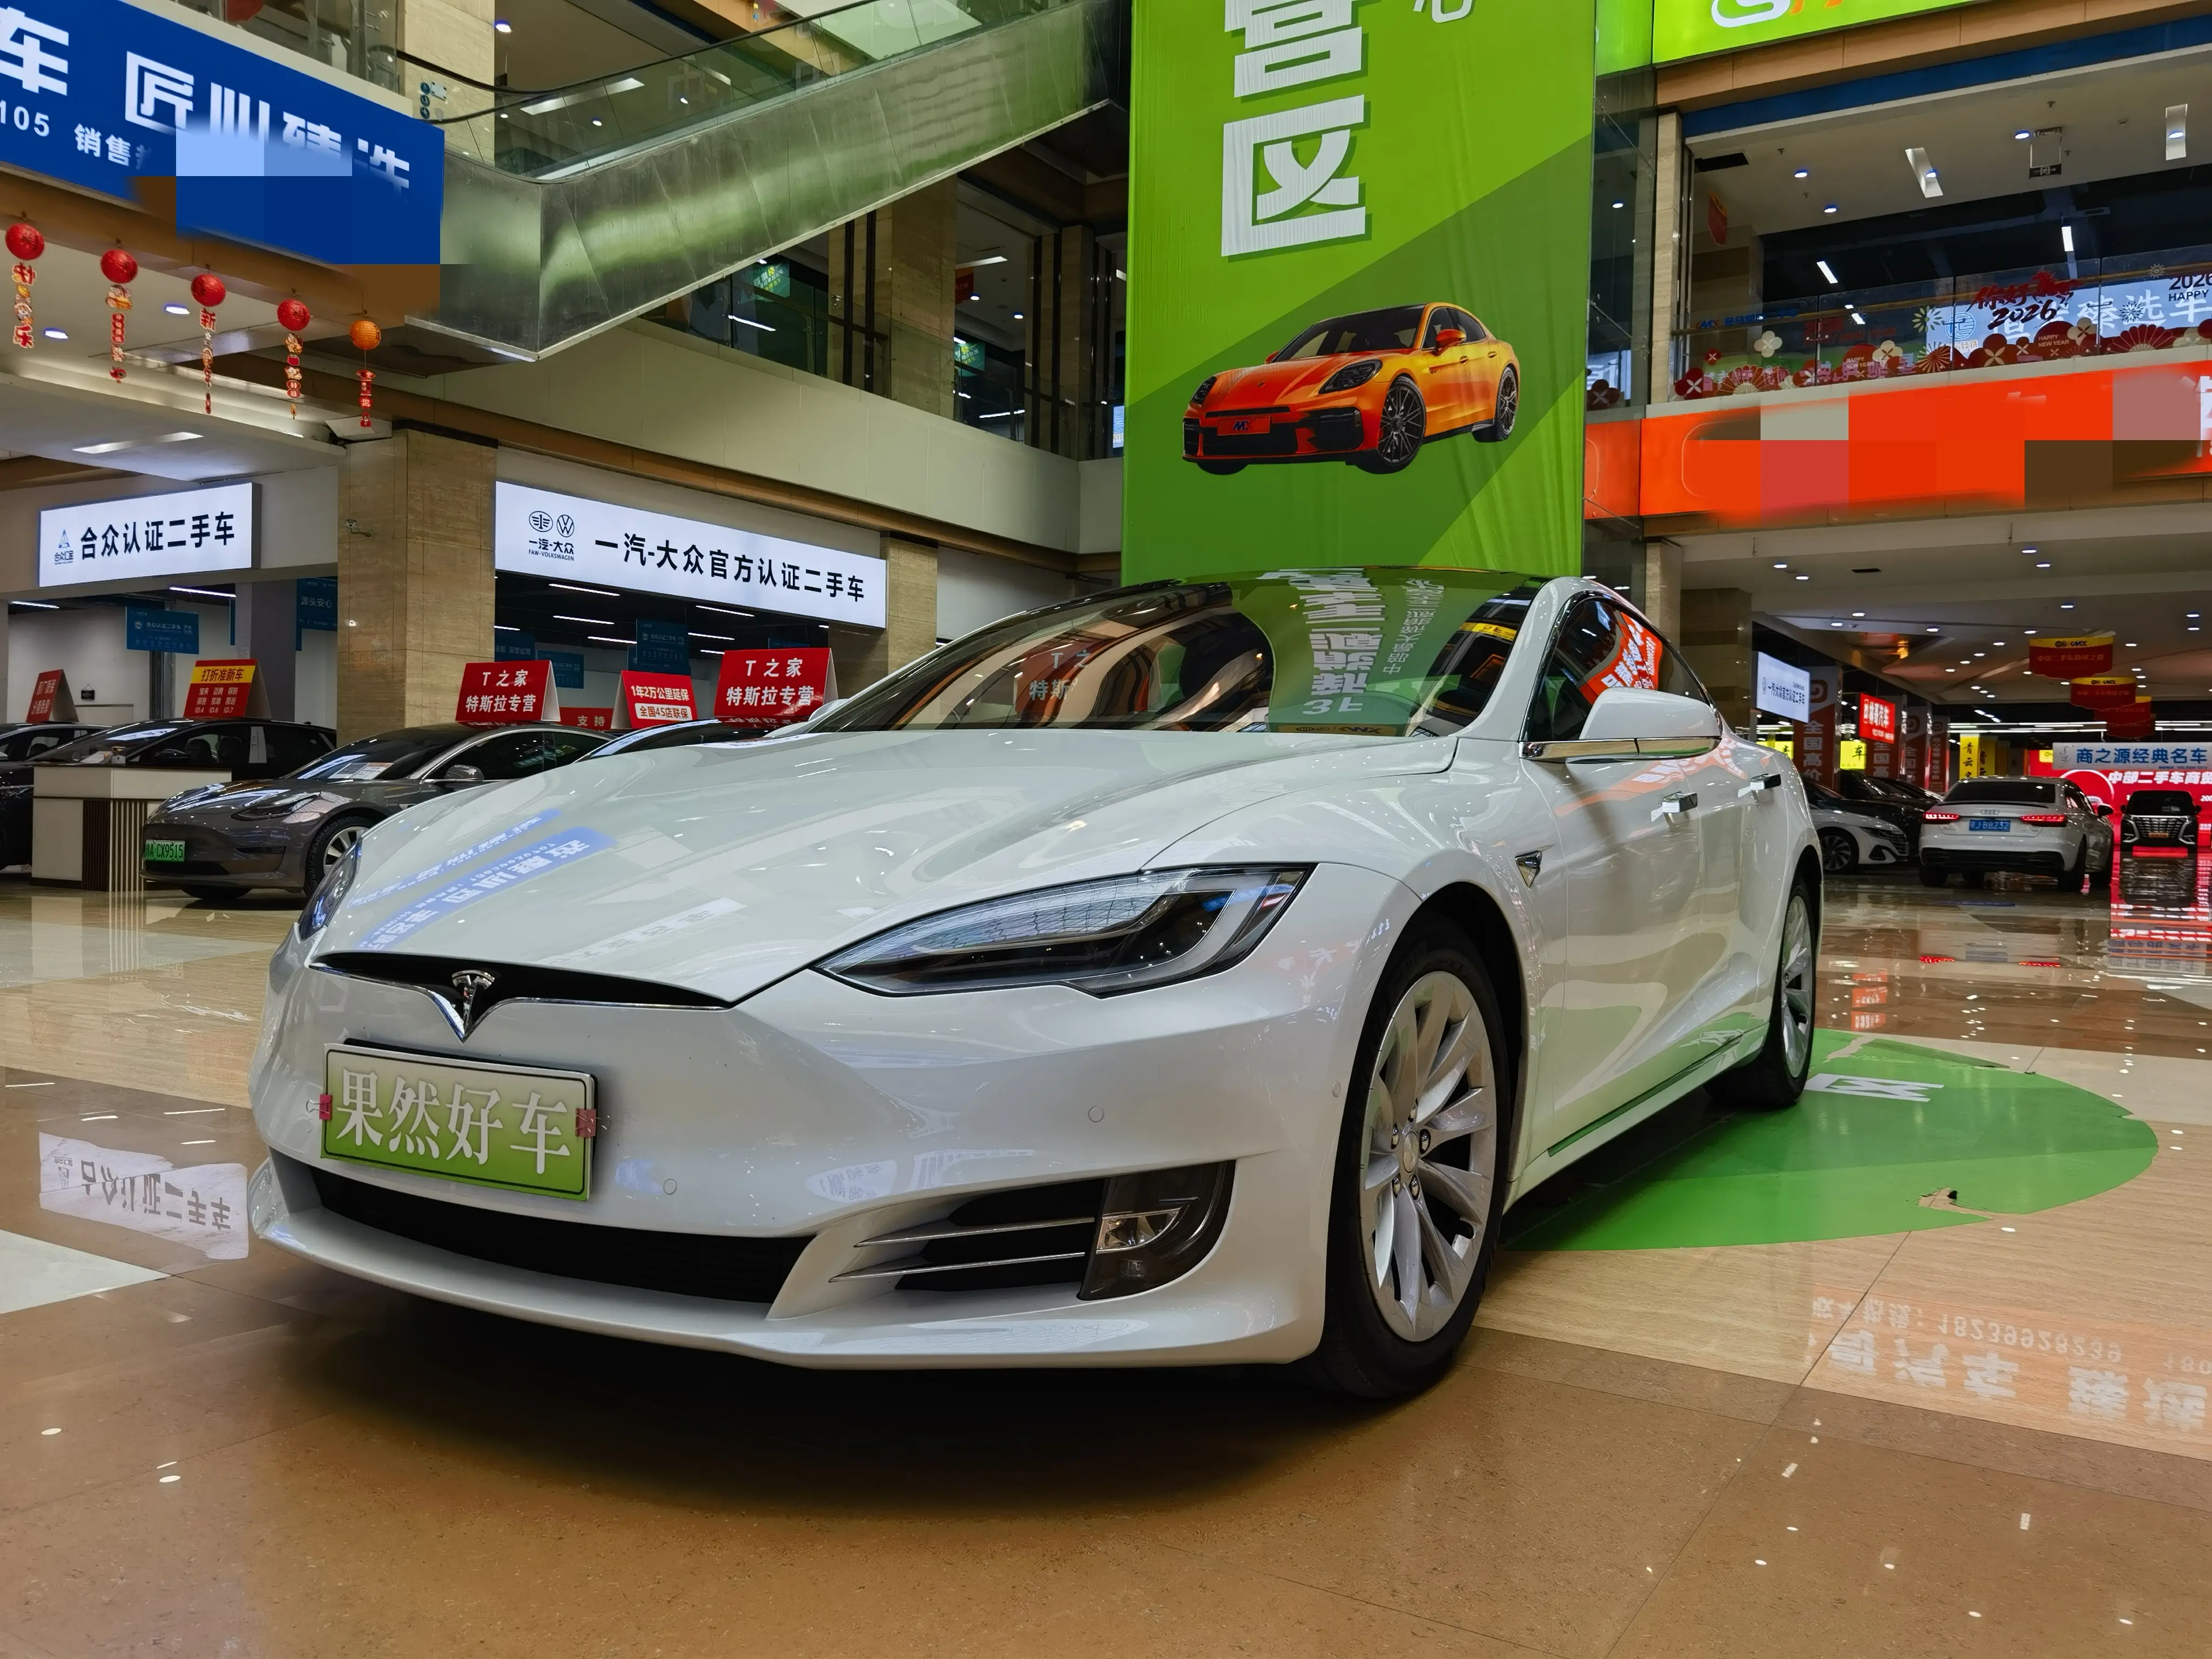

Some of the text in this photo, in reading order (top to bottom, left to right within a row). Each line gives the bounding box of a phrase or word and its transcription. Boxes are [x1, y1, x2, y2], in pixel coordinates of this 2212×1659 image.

[2169, 289, 2209, 302] HAPPY
[1988, 299, 2058, 330] 2026
[2038, 334, 2059, 342] HAPPY
[80, 511, 235, 559] 合众认证二手车
[528, 549, 575, 562] FAW-VOLKSWAGEN
[595, 532, 865, 602] 一汽-大众官方认证二手车
[201, 667, 245, 682] 打折准新车
[631, 685, 690, 702] 1年2万公里延保
[725, 685, 815, 706] 特斯拉专营
[465, 693, 537, 713] 特斯拉专营
[639, 705, 690, 719] 全国4S店联保
[577, 715, 606, 727] 支持
[2076, 747, 2208, 765] 商之源经典名车
[335, 1067, 571, 1175] 果然好车
